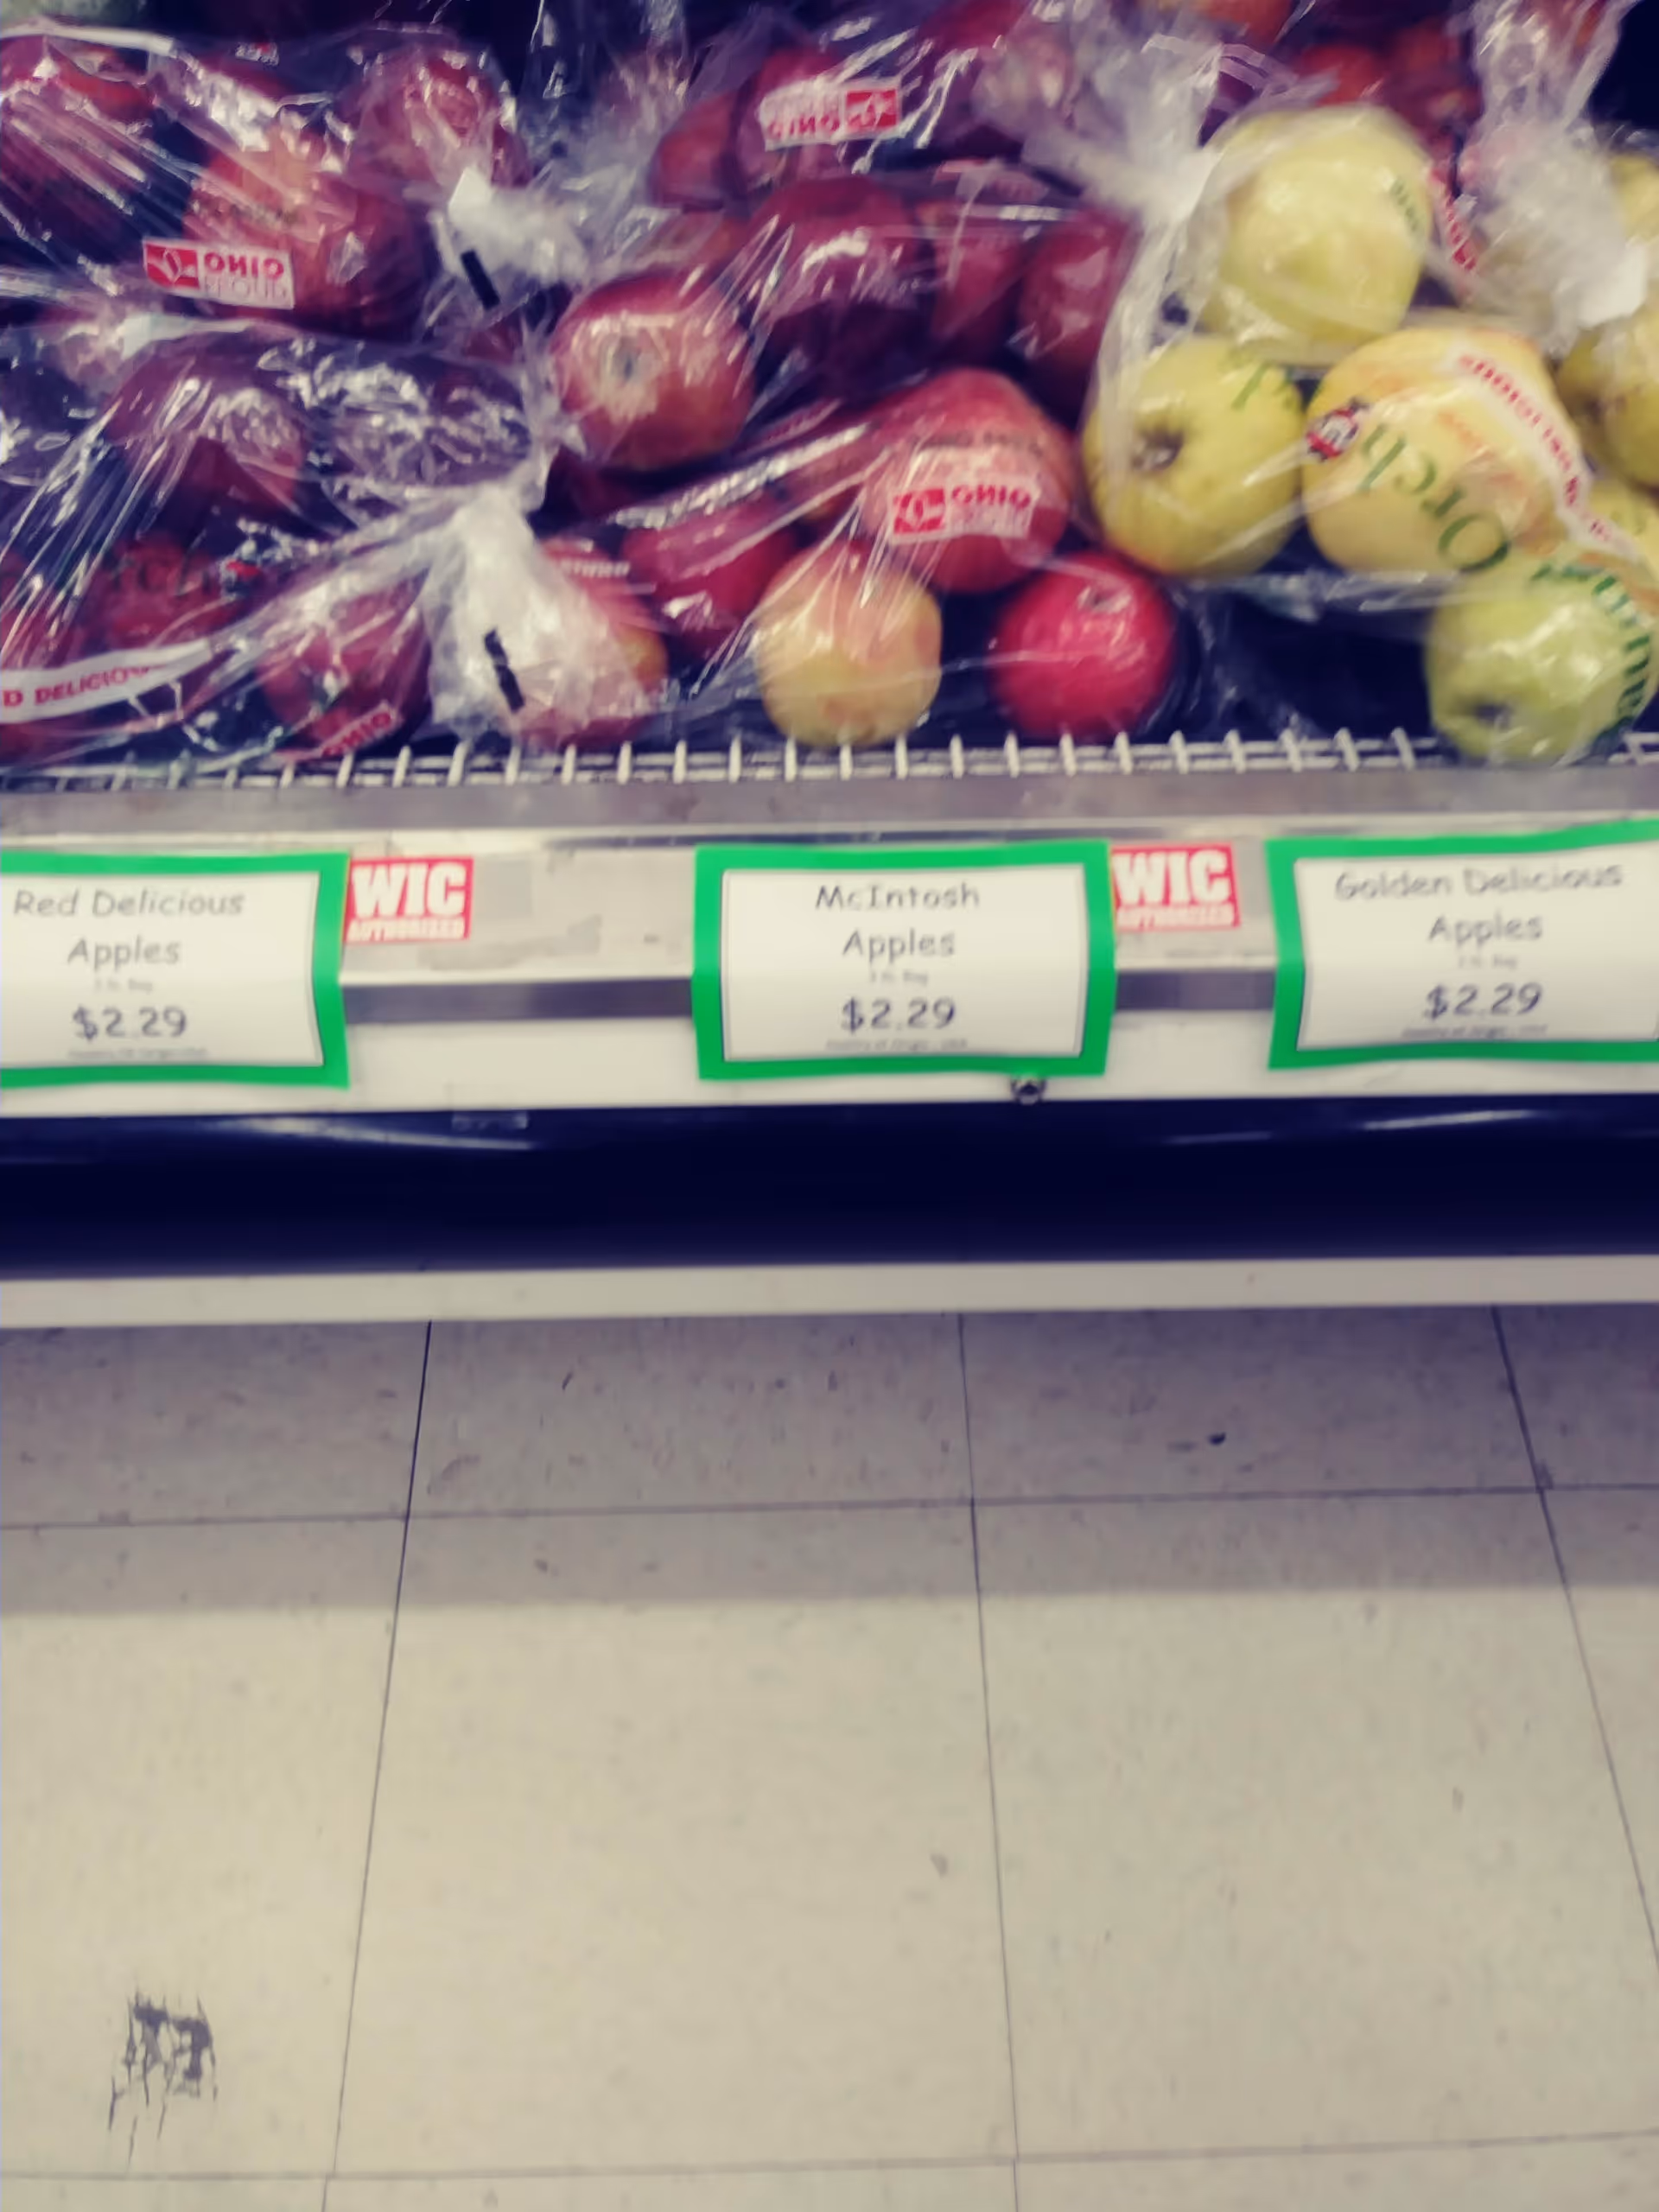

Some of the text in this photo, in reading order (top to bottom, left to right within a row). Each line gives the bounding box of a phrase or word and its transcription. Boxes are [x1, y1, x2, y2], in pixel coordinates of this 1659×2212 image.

[204, 251, 285, 282] OHIO
[951, 482, 1033, 510] OHIO
[353, 862, 467, 917] WIC
[816, 882, 980, 910] McIntosh
[1112, 850, 1229, 906] WIC
[1334, 863, 1623, 899] Golden Delicious
[14, 888, 245, 917] Red Delicious
[843, 926, 957, 964] Apples
[1428, 909, 1544, 949] Apples
[67, 933, 181, 973] Apples
[842, 995, 957, 1036] $2.29
[1426, 982, 1544, 1020] $2.29
[73, 1005, 188, 1042] $2.29
